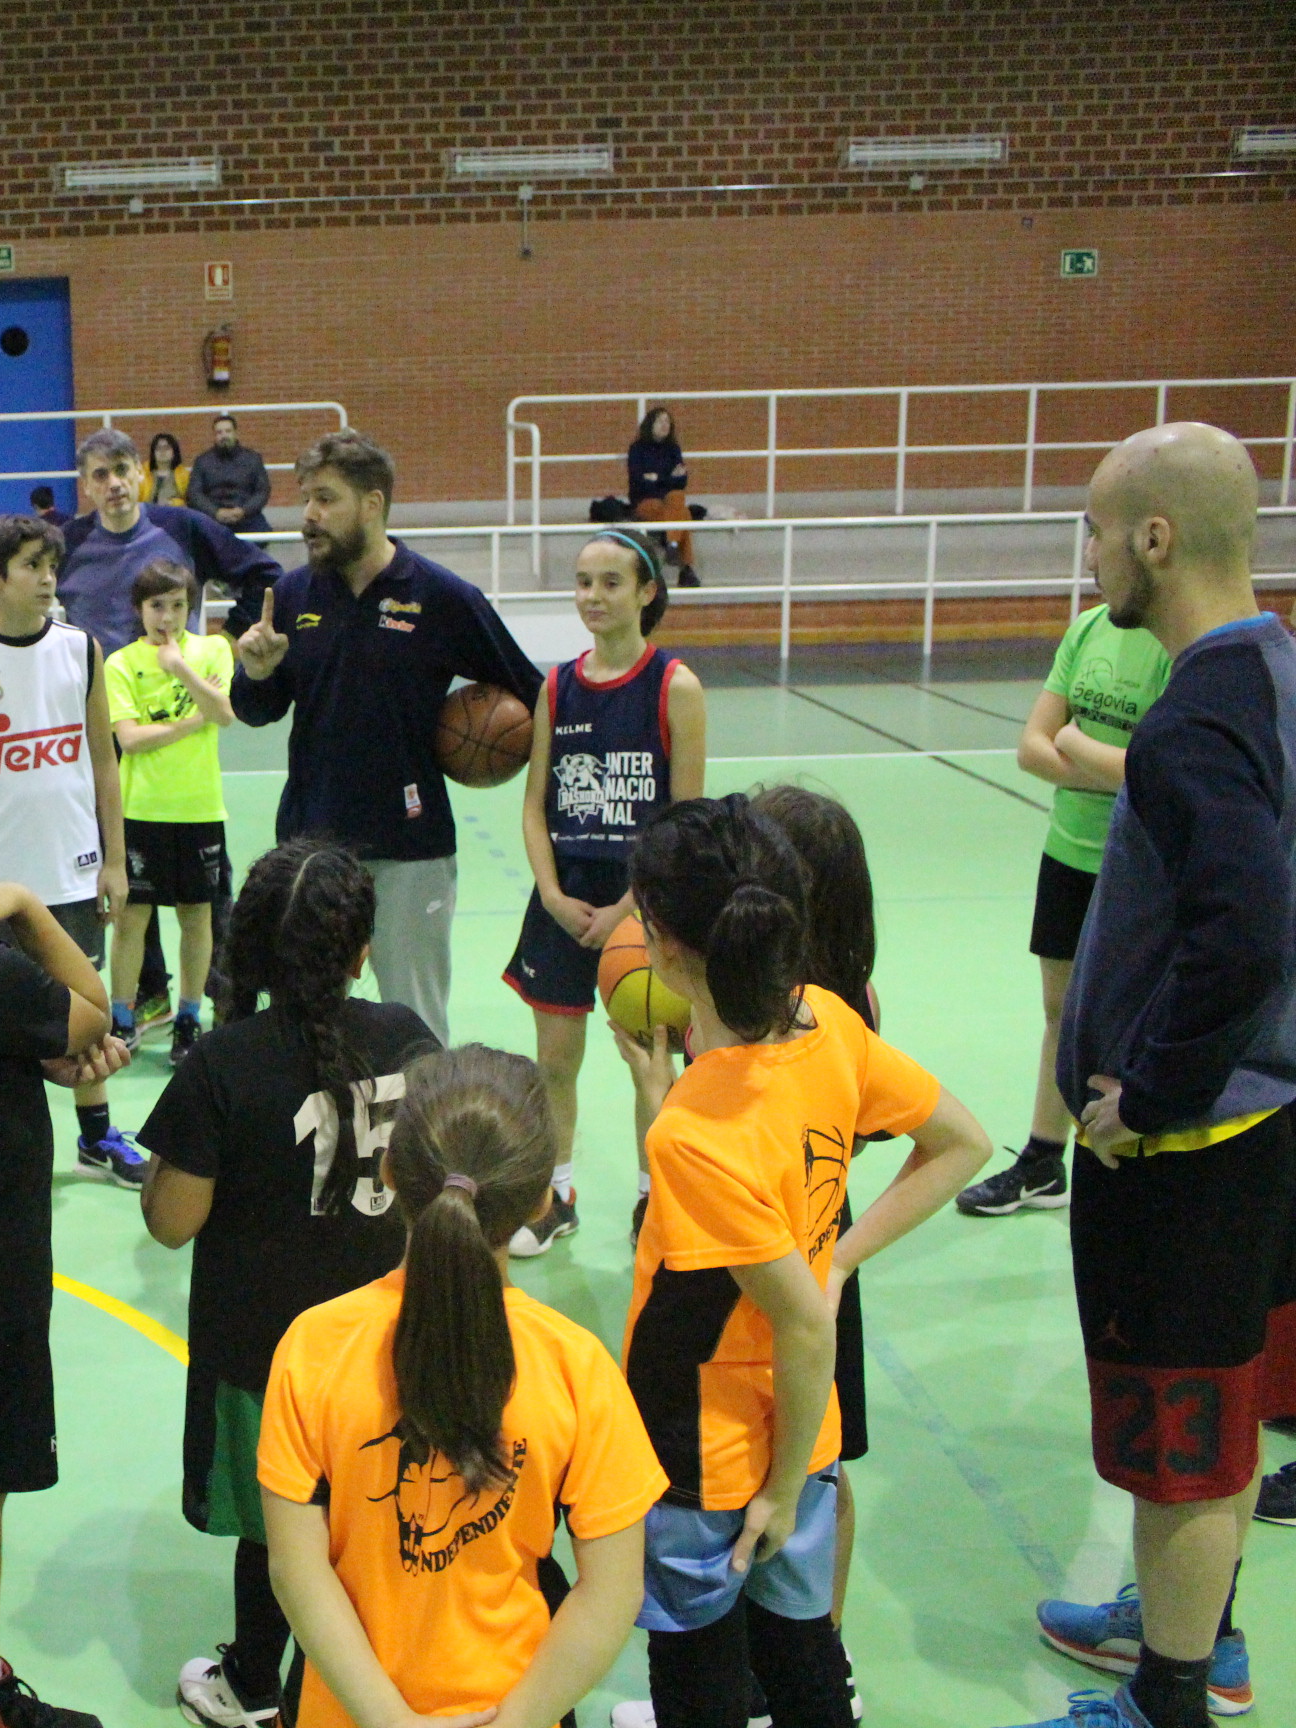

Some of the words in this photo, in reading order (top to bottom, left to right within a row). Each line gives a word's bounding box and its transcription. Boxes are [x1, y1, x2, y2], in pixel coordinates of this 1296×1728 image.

[1073, 682, 1138, 716] Segovia
[555, 723, 593, 736] KELME
[606, 751, 654, 777] INTER
[605, 776, 656, 802] NACIO
[602, 801, 637, 826] NAL
[292, 1072, 407, 1217] 15
[1104, 1376, 1221, 1477] 23
